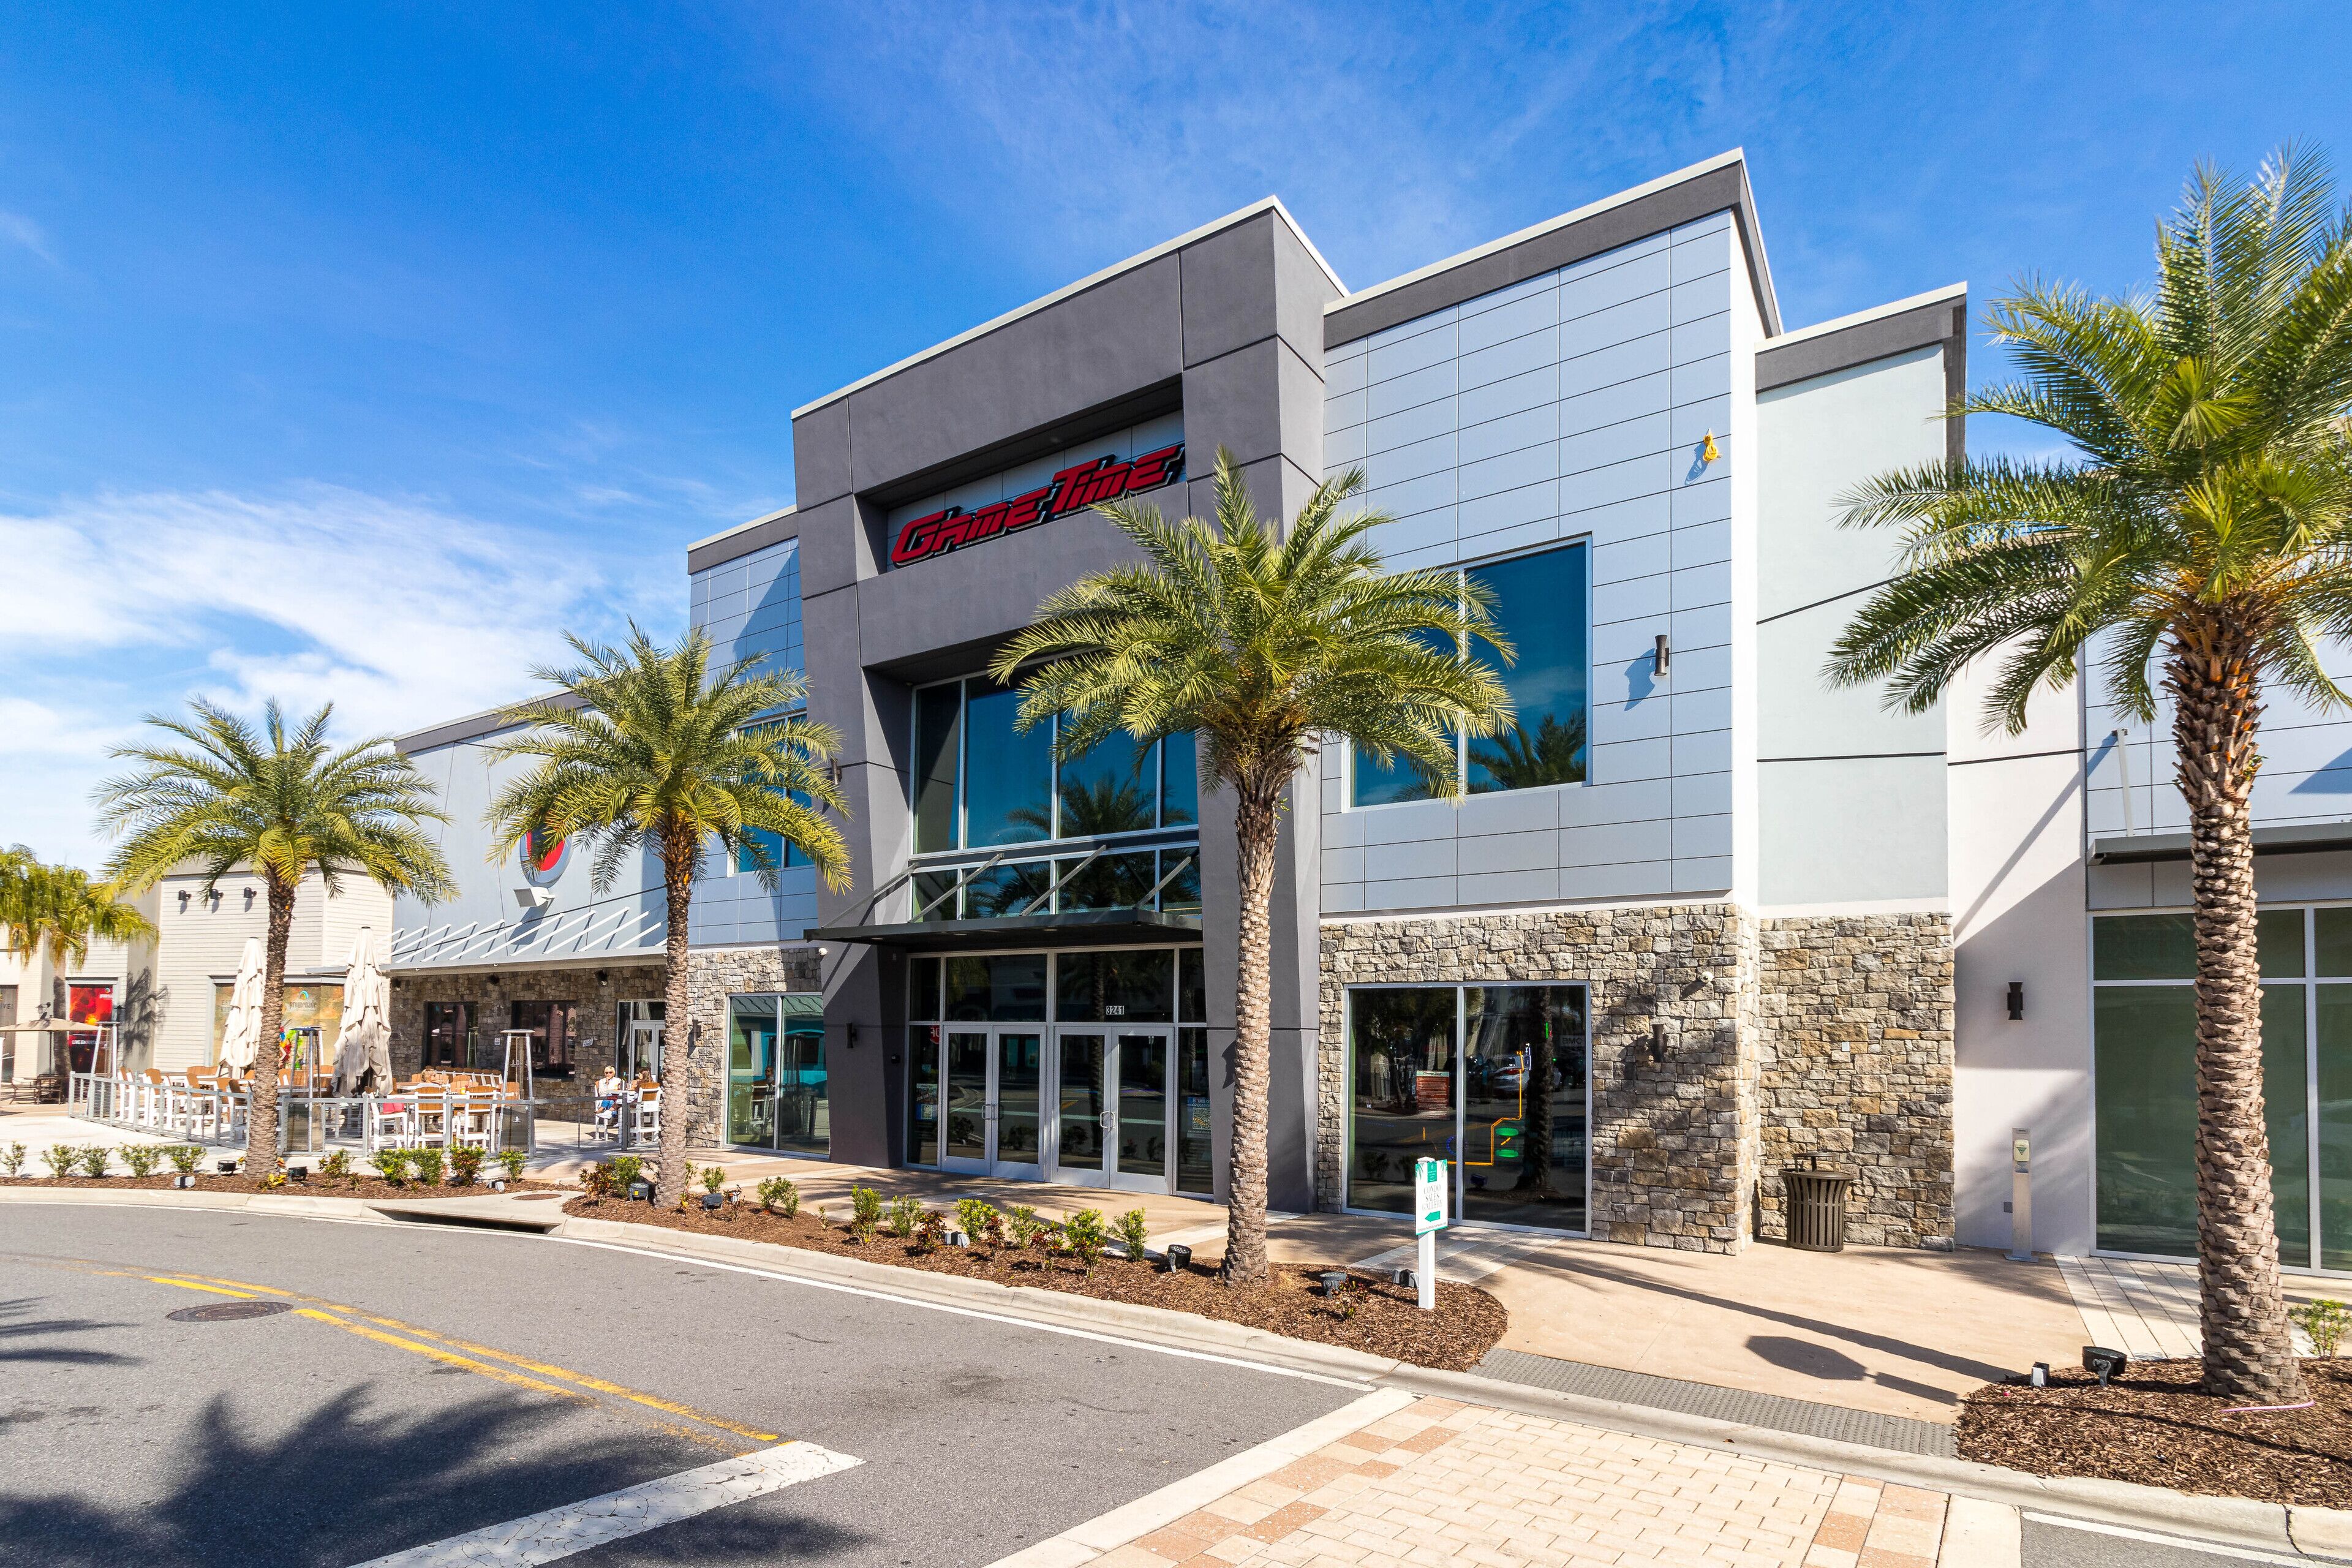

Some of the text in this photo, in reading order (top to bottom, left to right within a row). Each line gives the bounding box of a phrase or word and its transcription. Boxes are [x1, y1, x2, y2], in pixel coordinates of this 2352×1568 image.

[1107, 1006, 1123, 1014] 3241
[1423, 1185, 1441, 1194] CONDO
[1425, 1194, 1439, 1202] SALES
[1422, 1200, 1442, 1211] GALLERY
